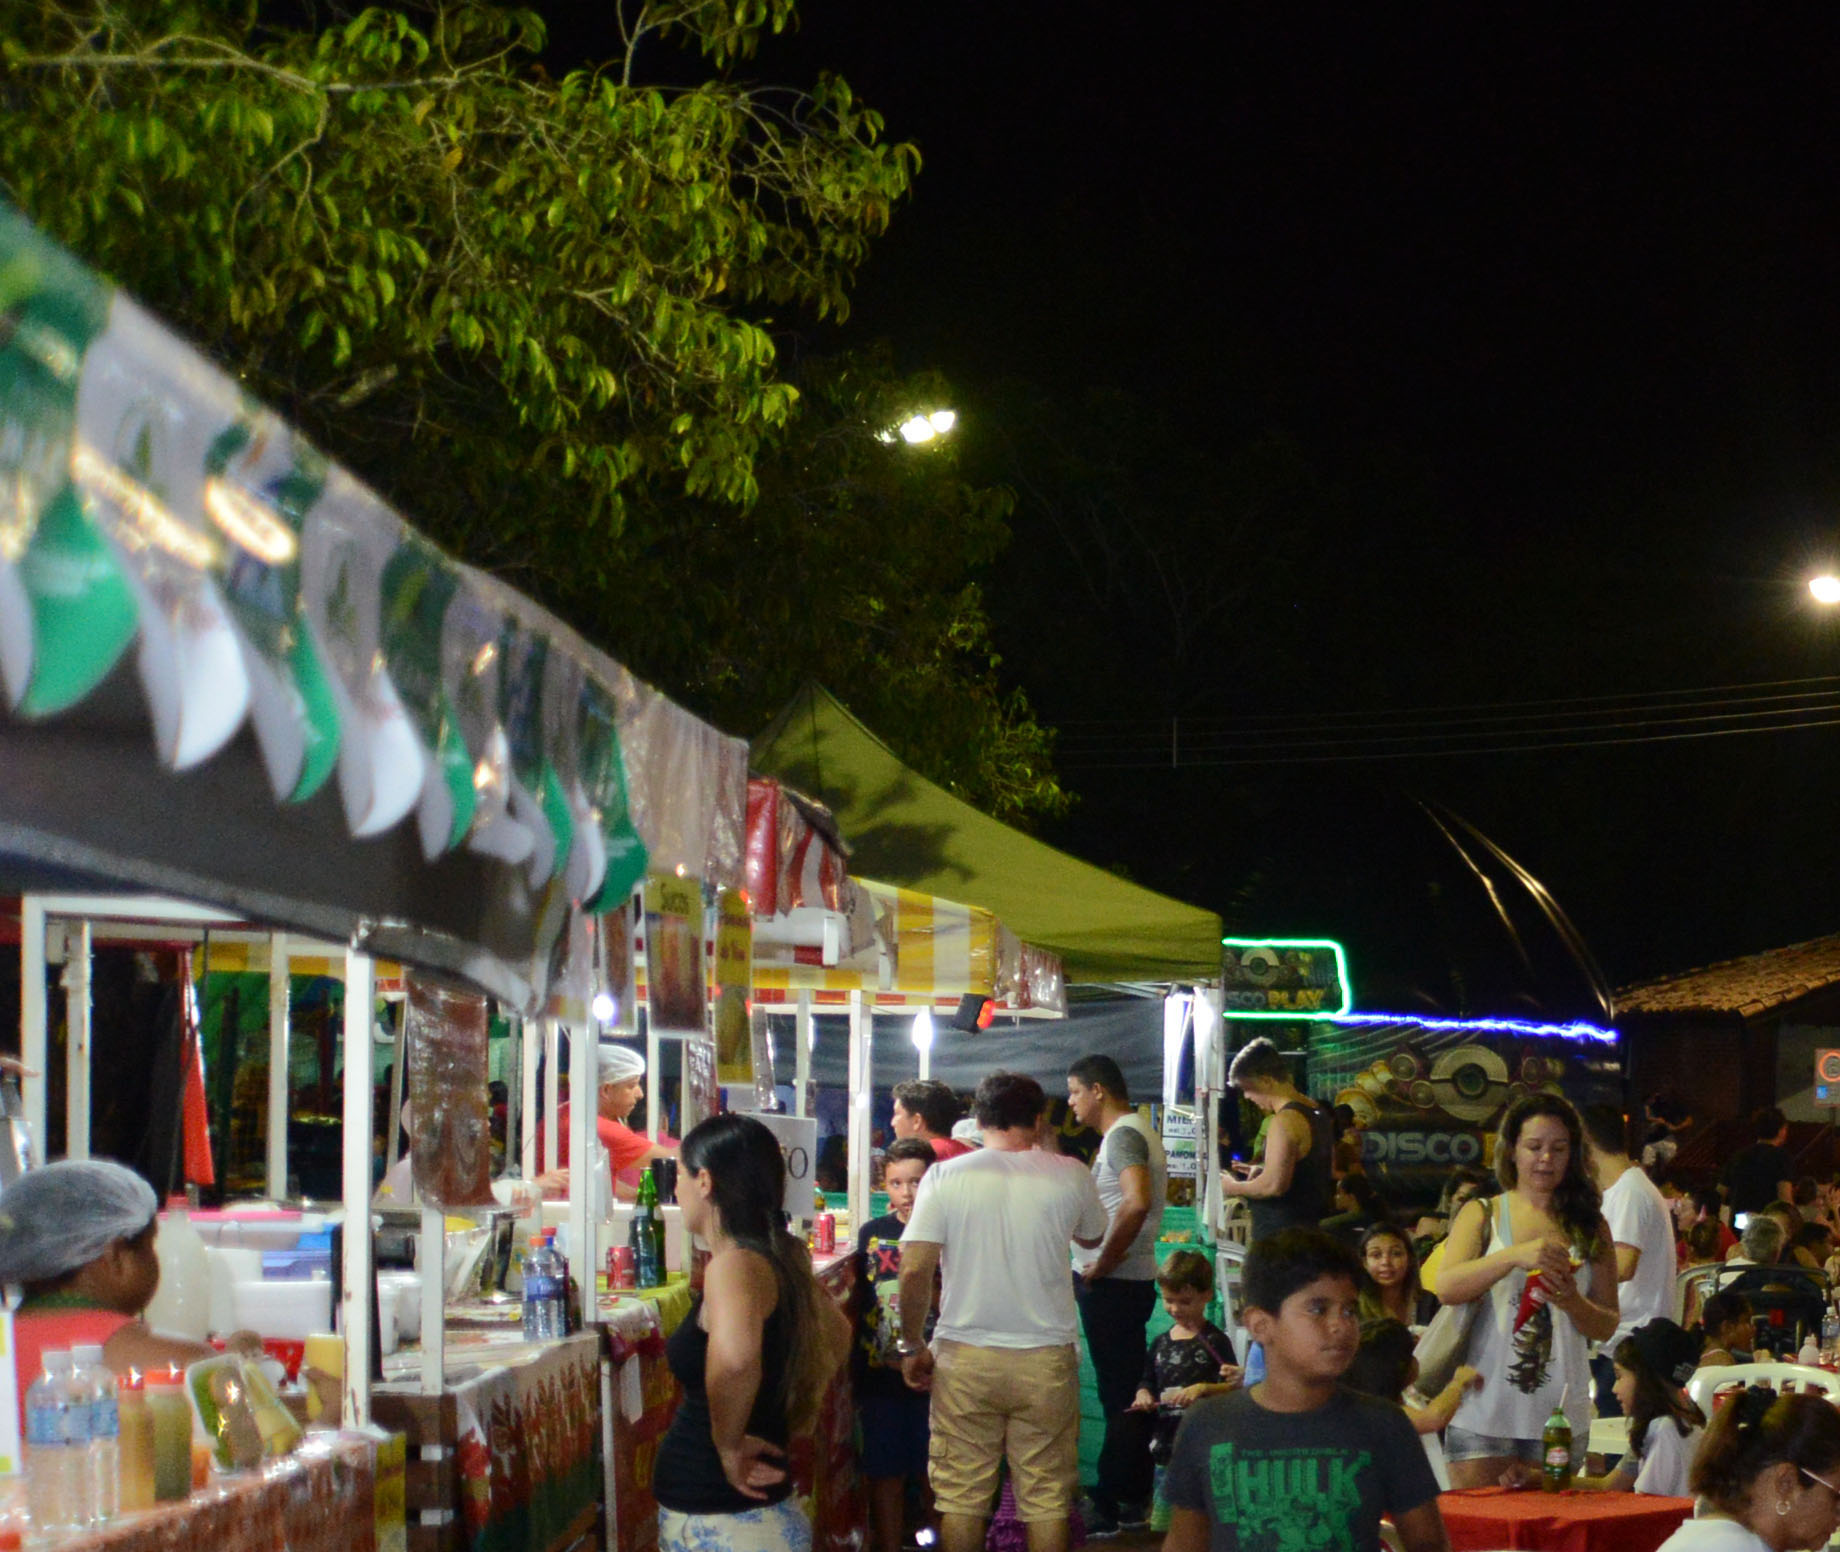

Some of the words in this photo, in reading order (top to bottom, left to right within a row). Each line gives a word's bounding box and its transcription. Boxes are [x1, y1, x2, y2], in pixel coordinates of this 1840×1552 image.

[1267, 989, 1326, 1010] PLAY
[1363, 1131, 1481, 1162] DISCO
[1236, 1451, 1372, 1506] HULK
